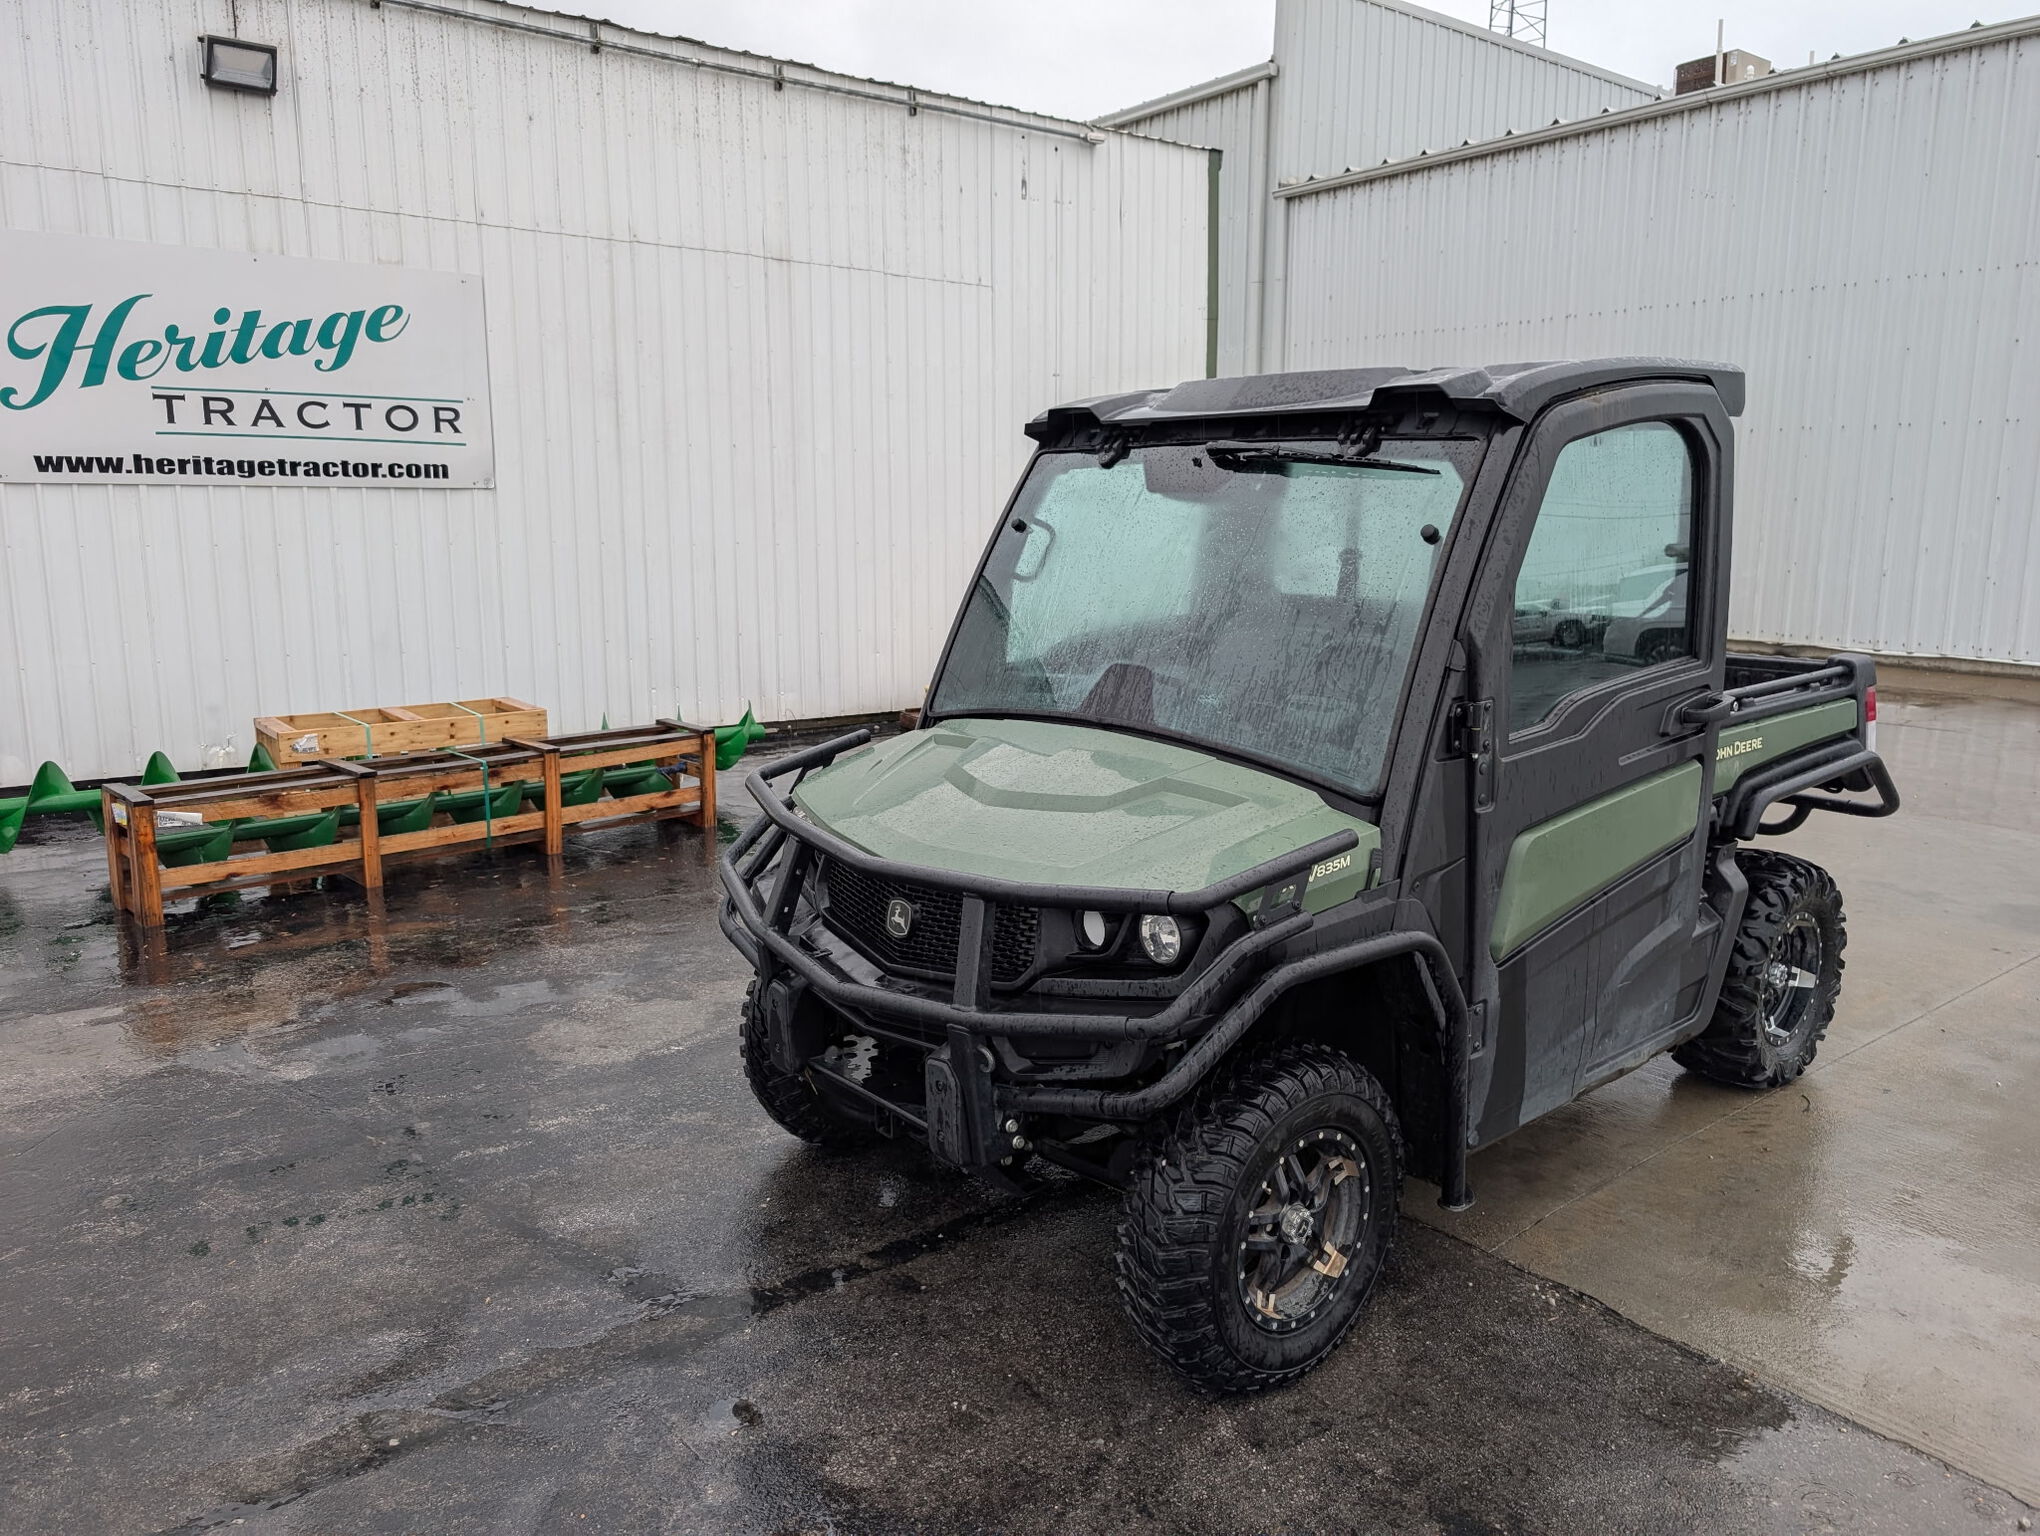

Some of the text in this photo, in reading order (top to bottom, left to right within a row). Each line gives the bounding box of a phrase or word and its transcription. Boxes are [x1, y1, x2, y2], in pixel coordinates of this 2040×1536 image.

[0, 294, 411, 411] Heritage
[152, 393, 464, 434] TRACTOR
[34, 453, 450, 479] www.heritagetractor.com
[1716, 737, 1763, 761] OHN DEERE
